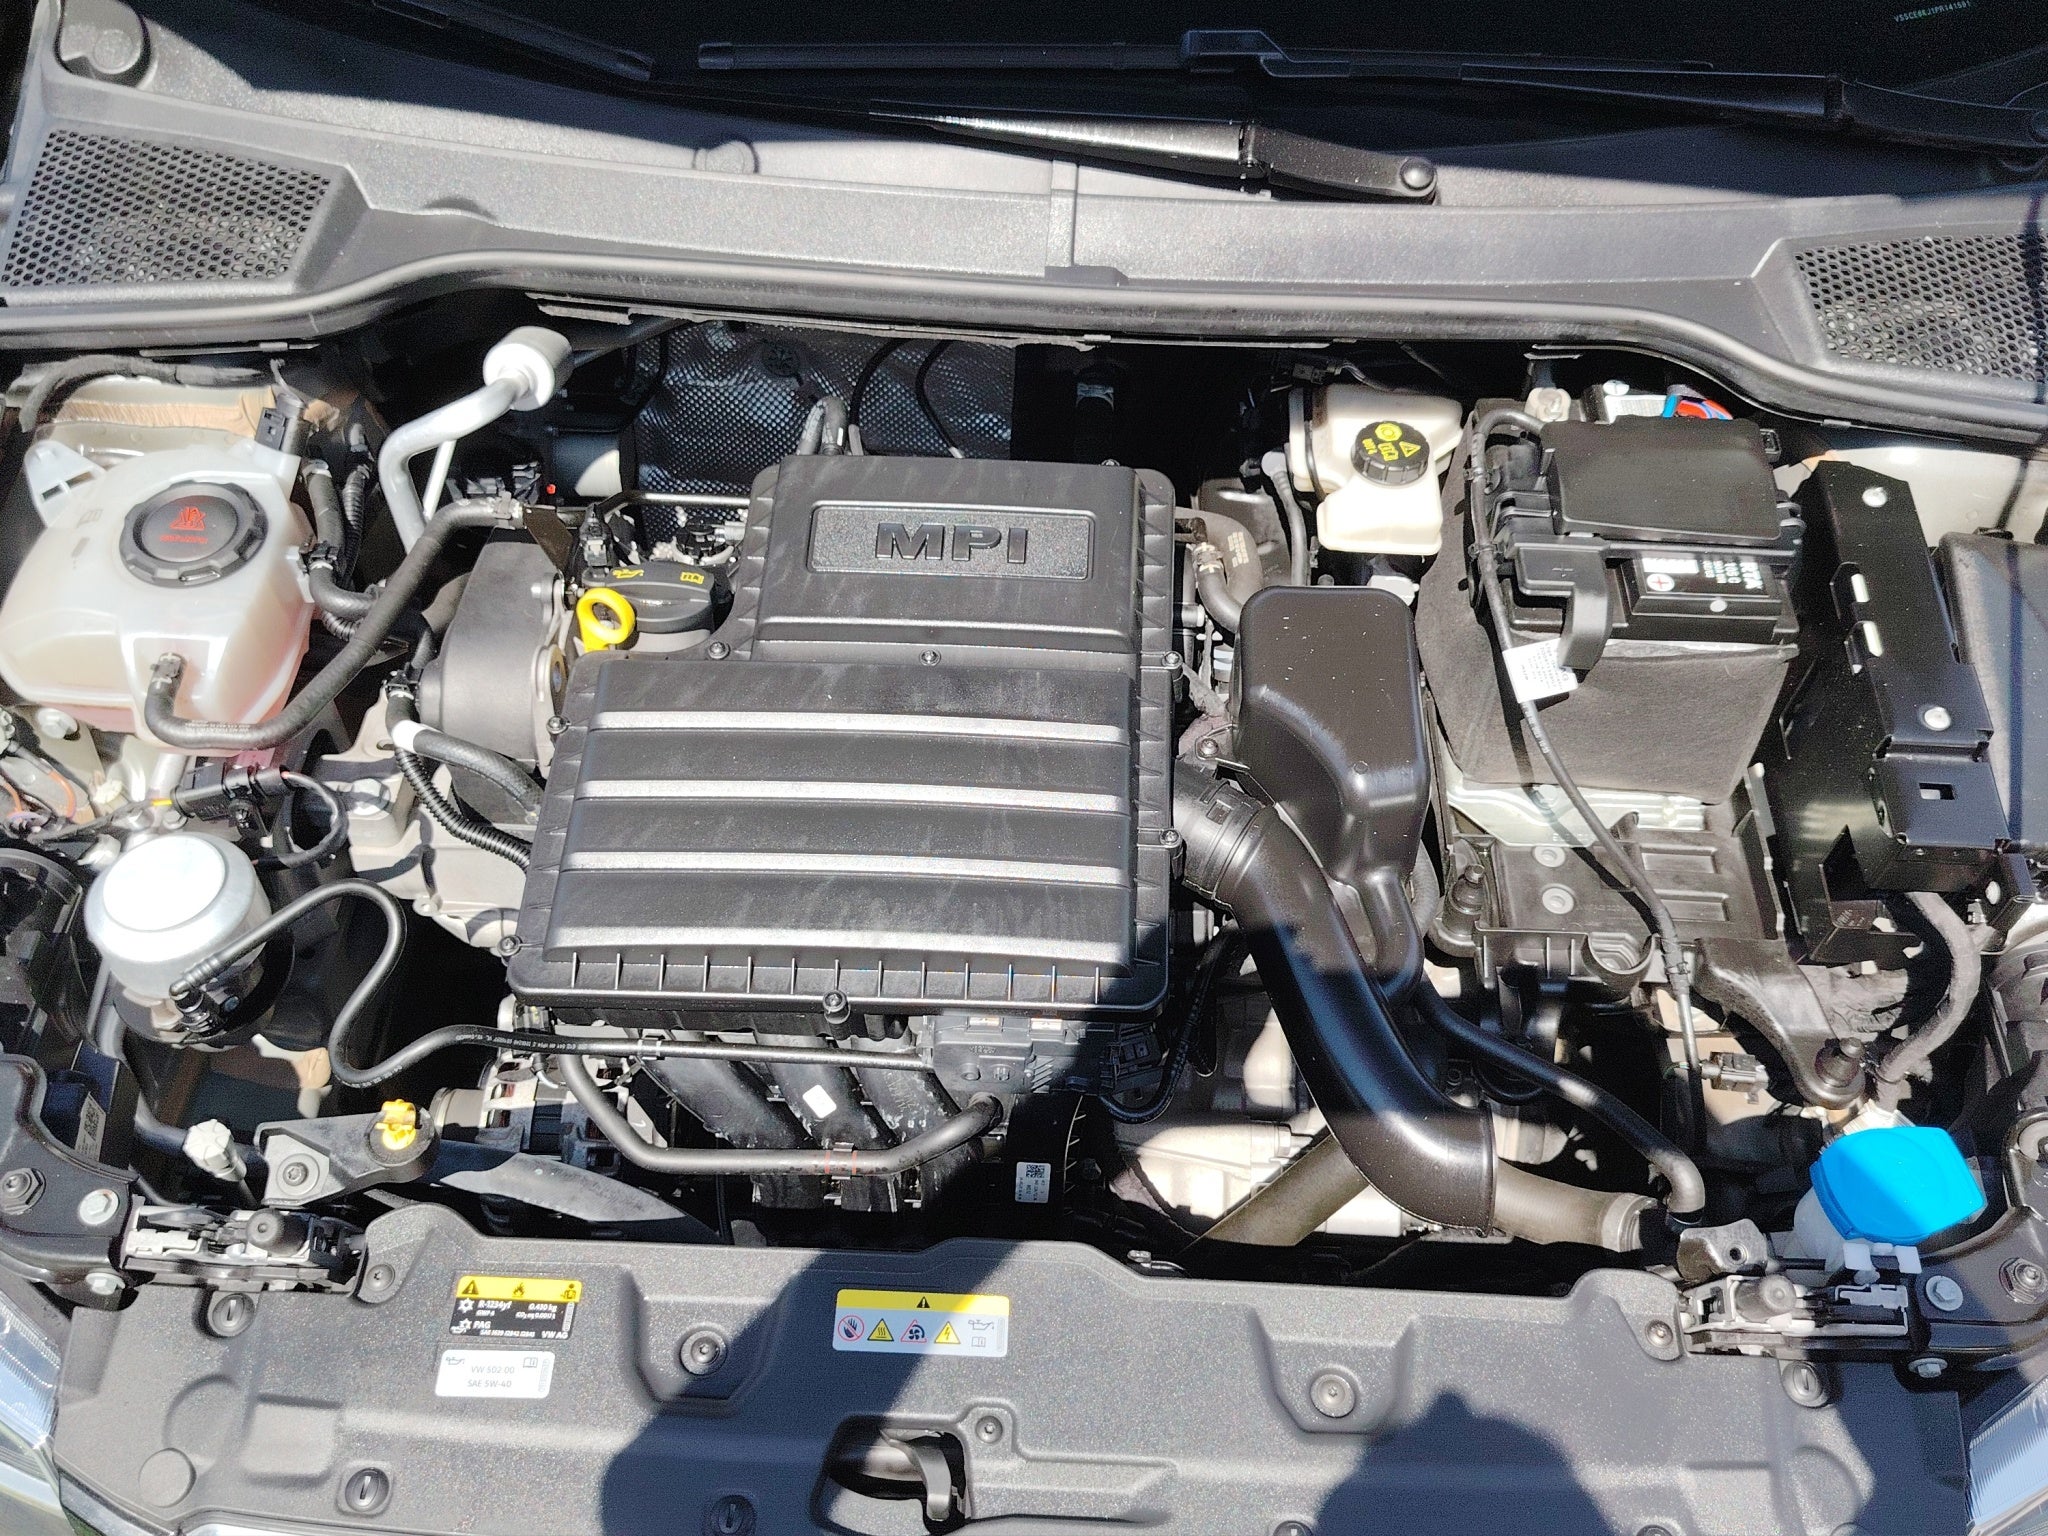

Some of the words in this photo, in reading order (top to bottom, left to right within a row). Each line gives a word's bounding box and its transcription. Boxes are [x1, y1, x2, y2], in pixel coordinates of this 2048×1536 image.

[875, 522, 1028, 564] MPI
[1740, 562, 1763, 589] RTA
[477, 1300, 512, 1312] R-1234yf
[548, 1304, 558, 1312] kg
[473, 1320, 491, 1329] PAG
[471, 1365, 485, 1374] VW
[486, 1366, 501, 1374] 502
[503, 1366, 515, 1374] 00
[467, 1379, 481, 1388] SAE
[484, 1380, 512, 1388] 5W-40
